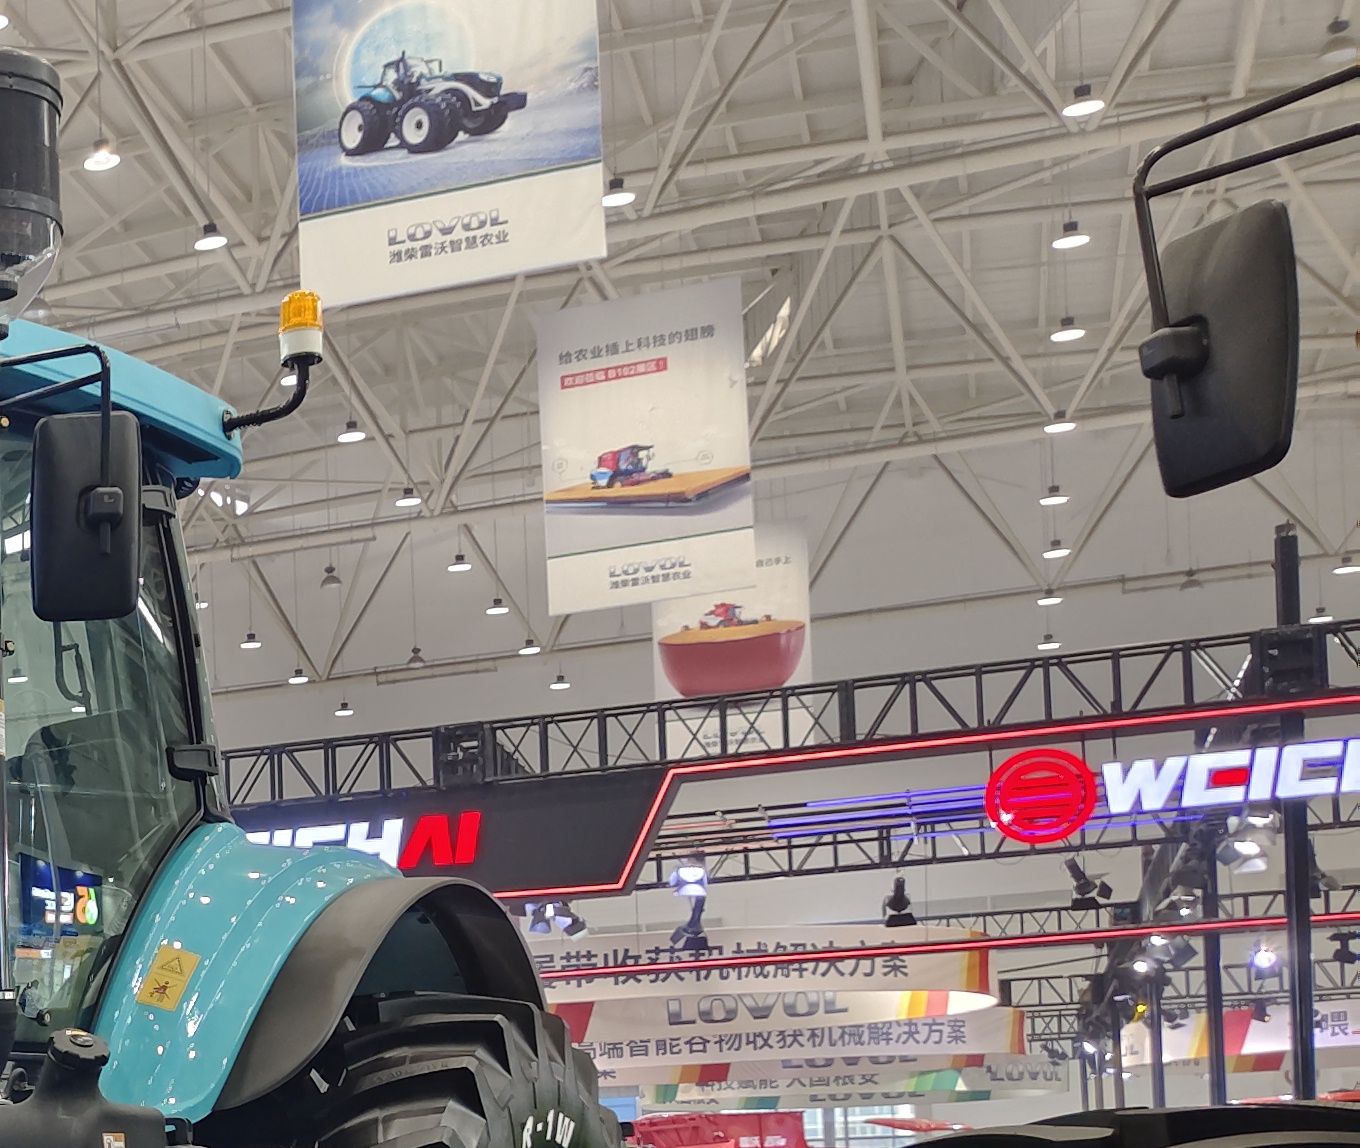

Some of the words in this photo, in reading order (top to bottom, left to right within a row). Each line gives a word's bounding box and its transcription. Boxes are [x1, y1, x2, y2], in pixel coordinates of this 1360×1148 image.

[387, 208, 509, 246] LOVOL
[389, 229, 510, 264] 潍柴雷沃智慧农业
[609, 556, 691, 578] LOVOL
[667, 991, 849, 1026] LOVOL
